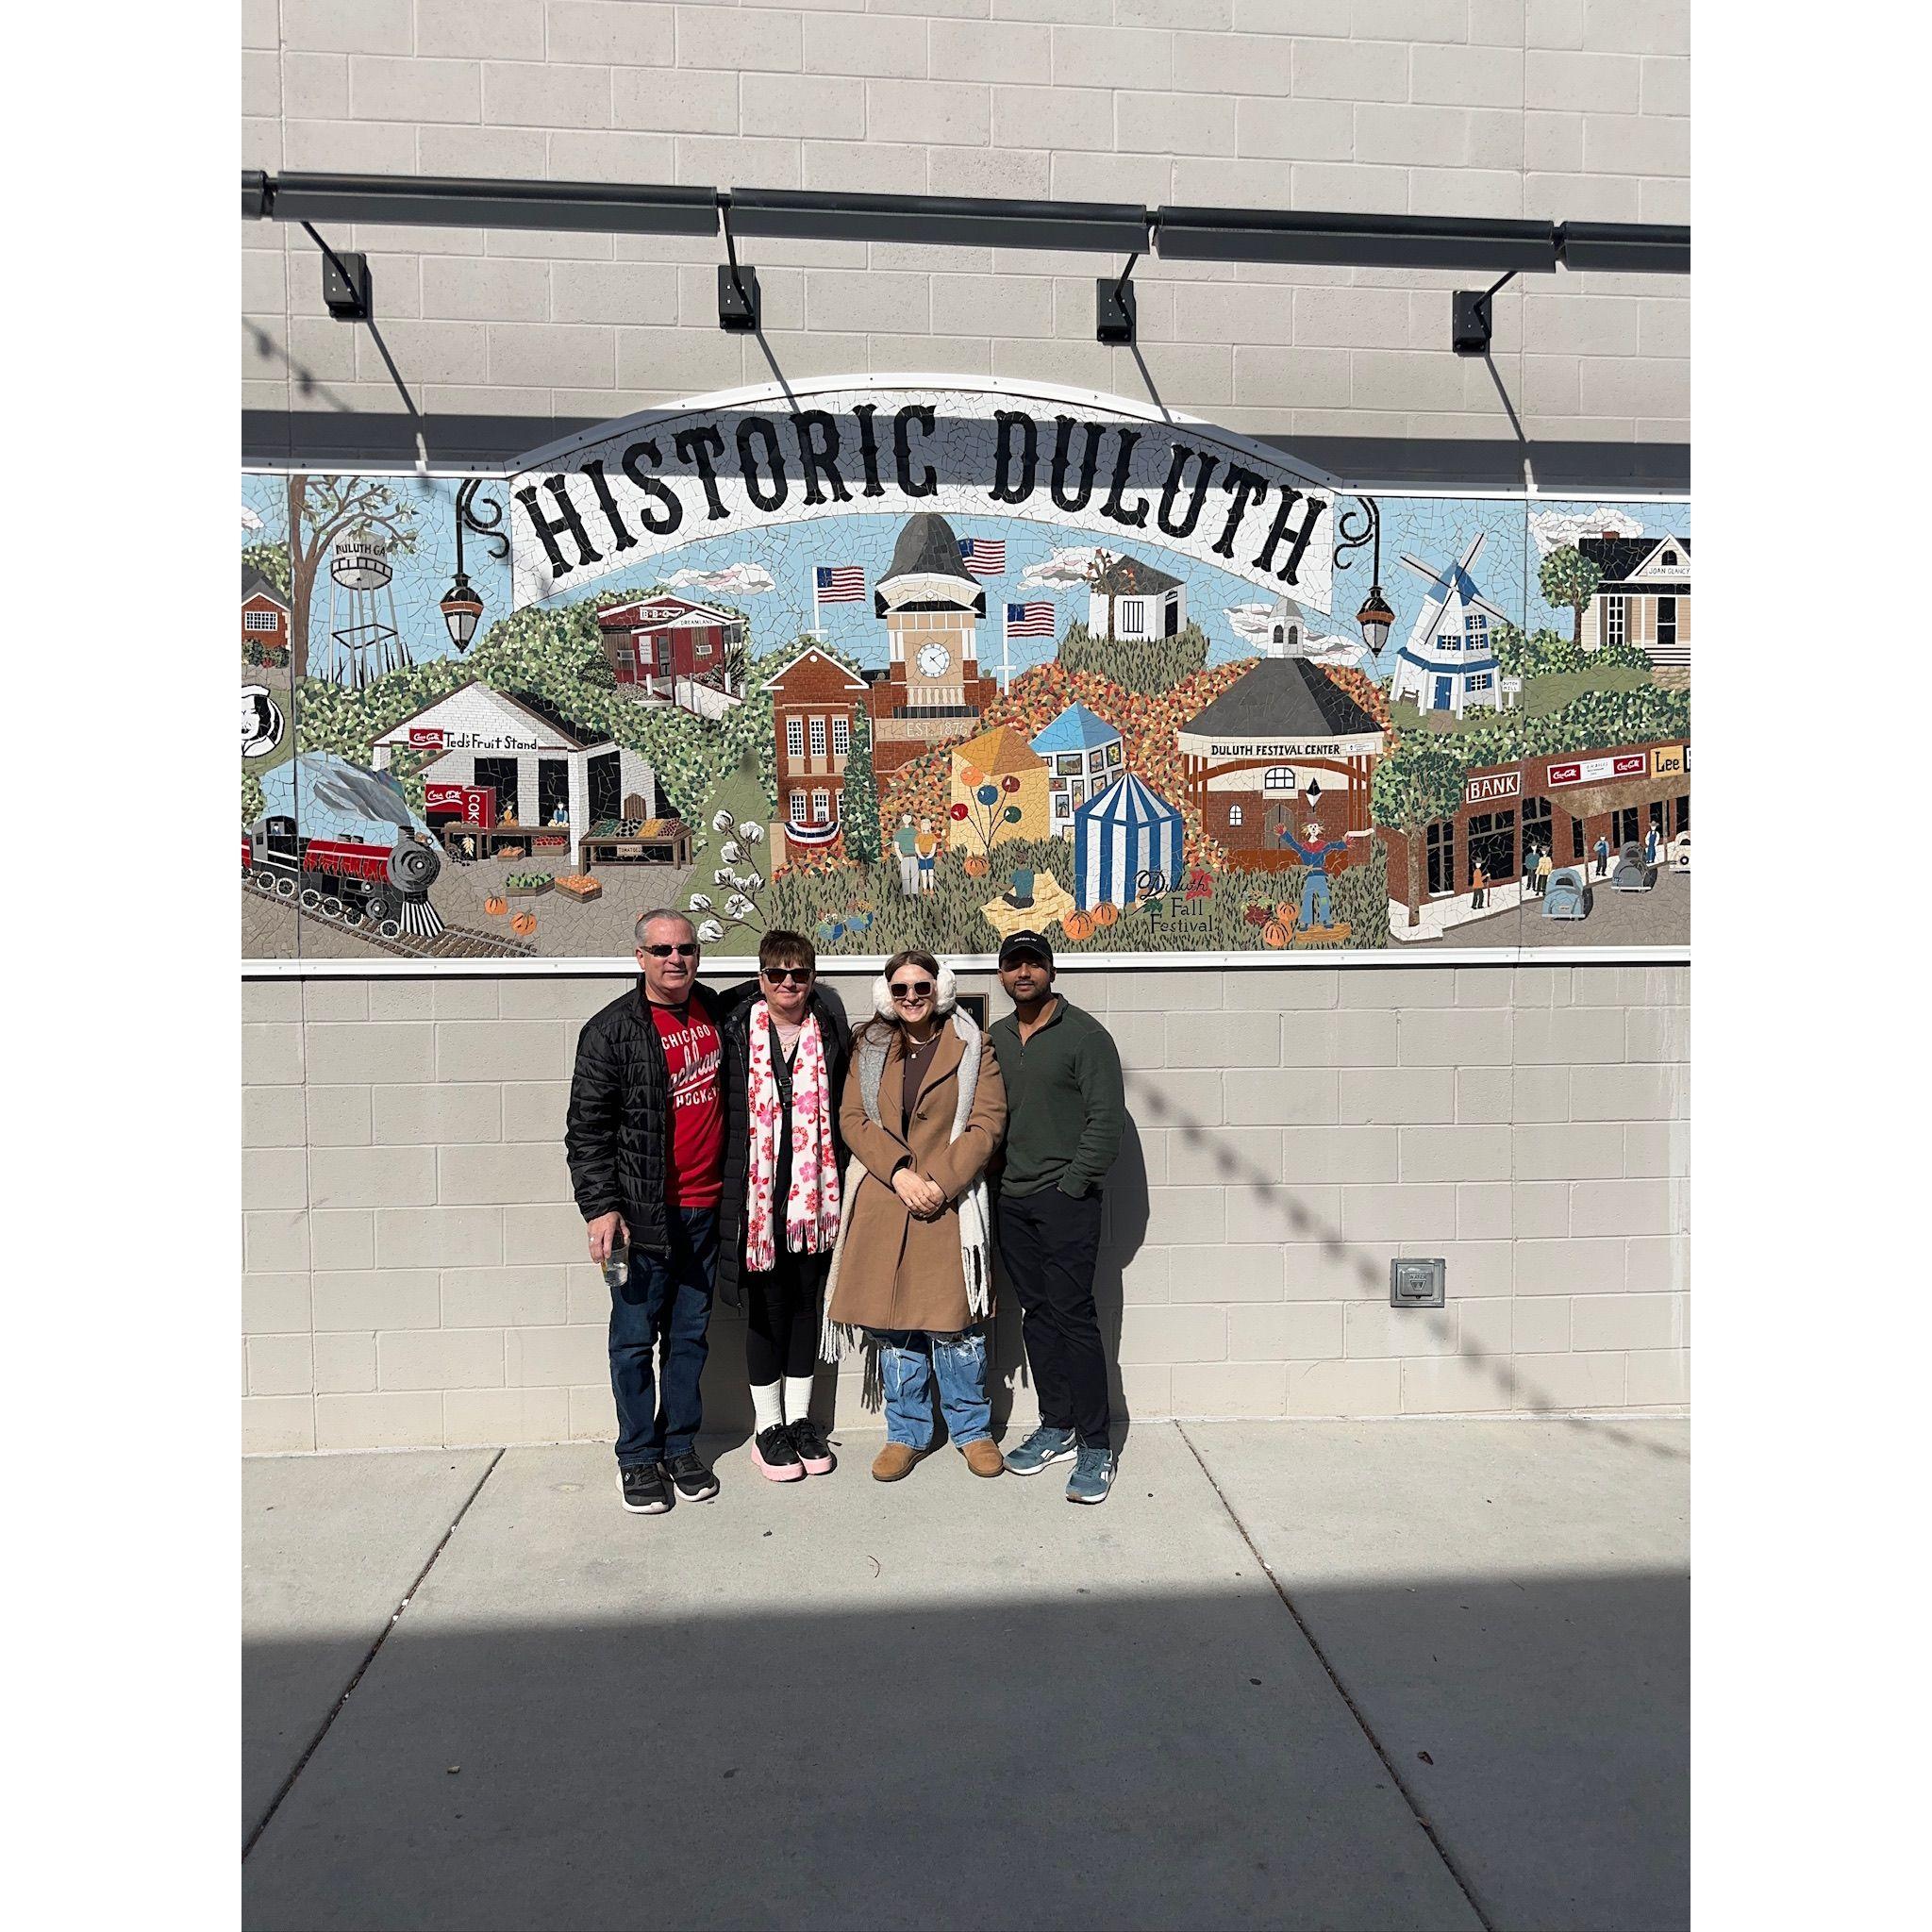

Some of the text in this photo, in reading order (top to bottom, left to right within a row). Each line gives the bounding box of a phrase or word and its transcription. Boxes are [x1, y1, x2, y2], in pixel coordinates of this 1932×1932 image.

[515, 404, 1327, 586] HISTORIC DULUTH
[336, 543, 372, 555] DULUTH
[443, 732, 537, 750] Ted's Fruit Stand
[1211, 743, 1341, 756] DULUTH FESTIVAL CENTER
[1655, 751, 1680, 773] Lee
[1471, 775, 1516, 799] BANK
[468, 794, 480, 824] COK
[1133, 869, 1210, 901] Duluth
[1171, 897, 1203, 918] Fall
[1150, 913, 1214, 934] Festival
[660, 1024, 711, 1051] CHICAGO
